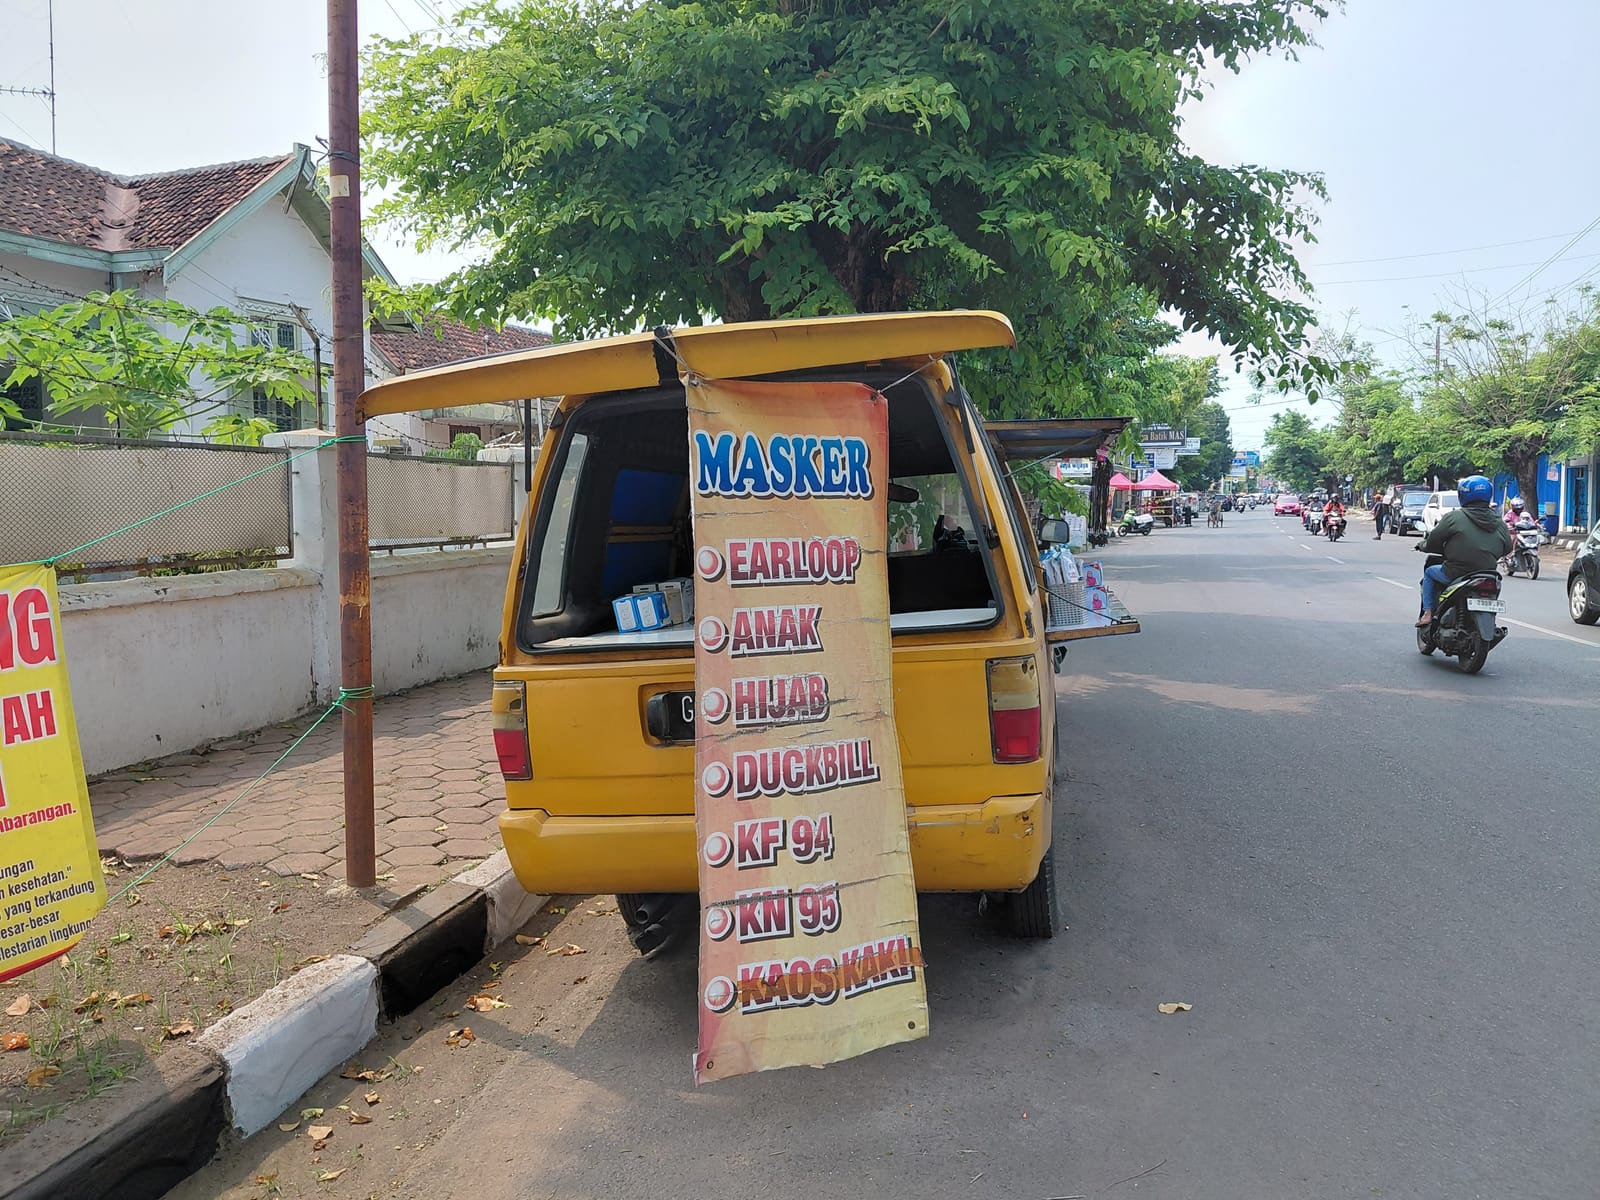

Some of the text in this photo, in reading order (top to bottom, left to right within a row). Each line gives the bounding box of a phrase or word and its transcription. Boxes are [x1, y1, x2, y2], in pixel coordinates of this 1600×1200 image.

[1150, 432, 1167, 440] Batik
[1169, 430, 1185, 440] MAS
[694, 430, 873, 497] MASKER
[726, 537, 861, 586] EARLOOP
[729, 605, 823, 656] ANAK
[682, 695, 694, 723] G
[732, 672, 829, 726] HIJAB
[733, 737, 880, 800] DUCKBILL
[735, 813, 834, 869] KF 94
[4, 880, 95, 920] yang terkandung
[8, 866, 72, 897] kesehatan."
[0, 910, 61, 940] esar-besar
[736, 880, 841, 943] KN 95
[738, 934, 915, 1014] KAOS KAKI
